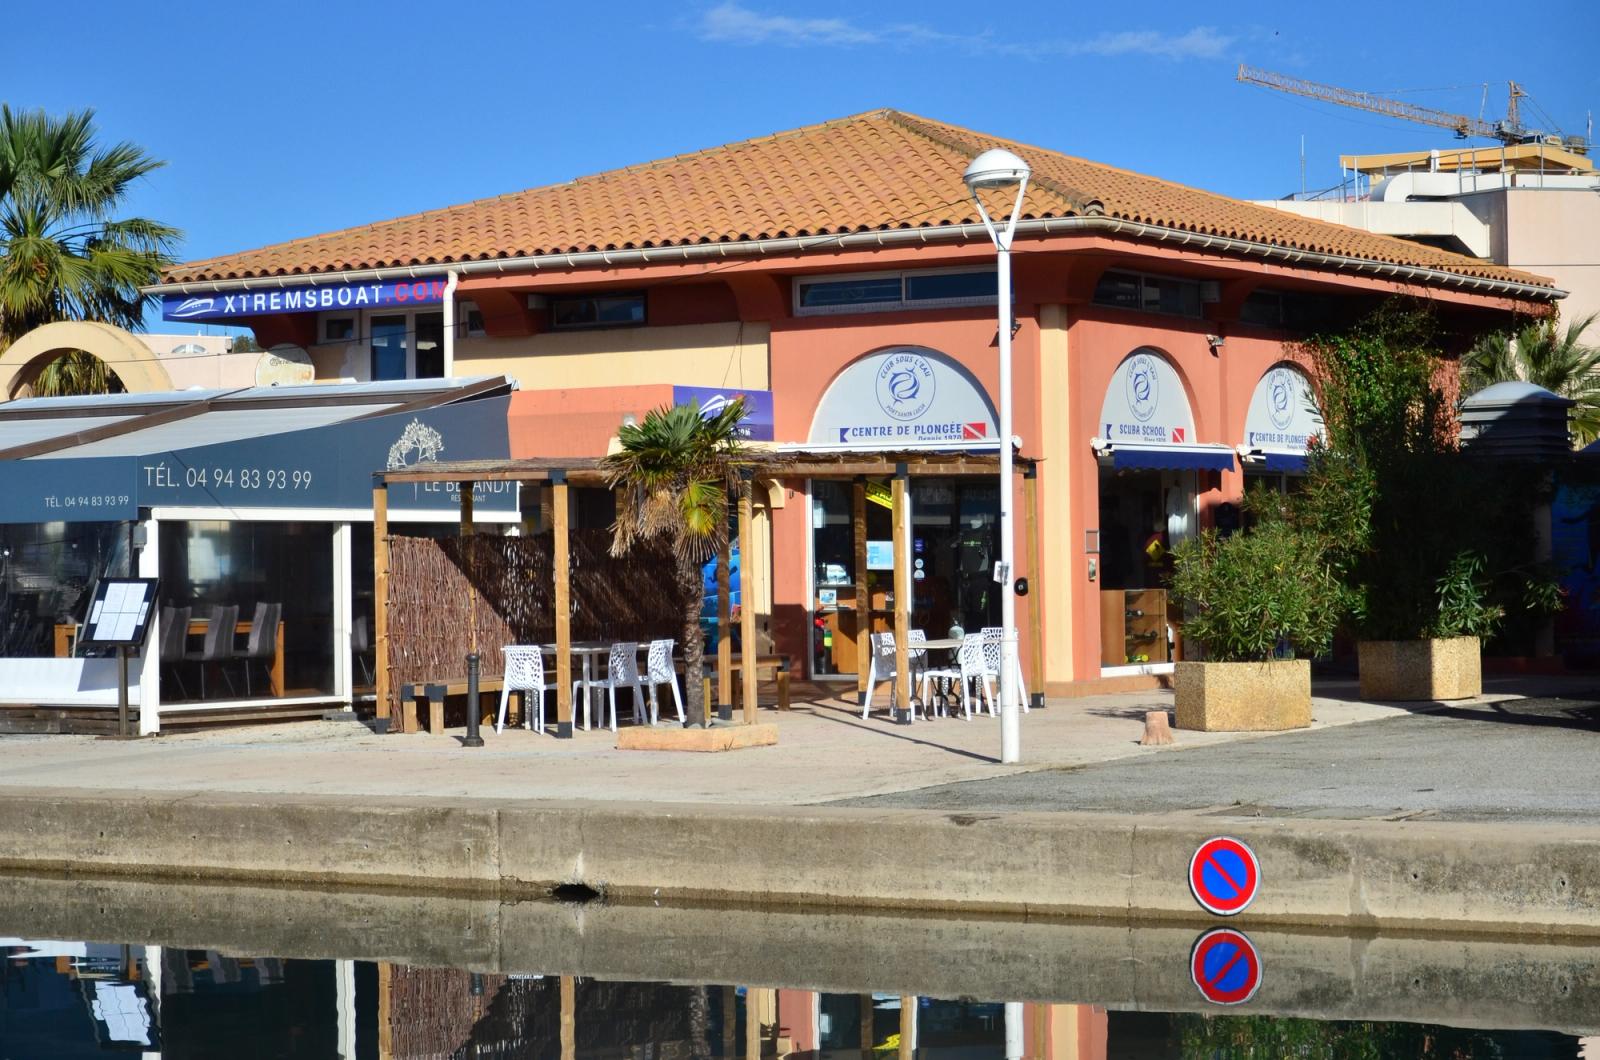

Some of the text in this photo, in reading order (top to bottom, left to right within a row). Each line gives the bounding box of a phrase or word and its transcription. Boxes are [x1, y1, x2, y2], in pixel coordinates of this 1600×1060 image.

[880, 360, 895, 379] CLUB
[895, 355, 914, 364] SOUS
[851, 421, 962, 437] CENTRE DE PLONGÉE
[1119, 424, 1166, 437] SCUBA SCHOOL
[1255, 432, 1275, 443] CENTRE
[1276, 433, 1284, 443] DE
[144, 462, 312, 490] TÉL. 04 94 83 93 99
[64, 496, 75, 507] 04
[78, 496, 89, 507] 94
[91, 496, 102, 506] 83
[104, 495, 116, 506] 93
[118, 495, 129, 505] 99
